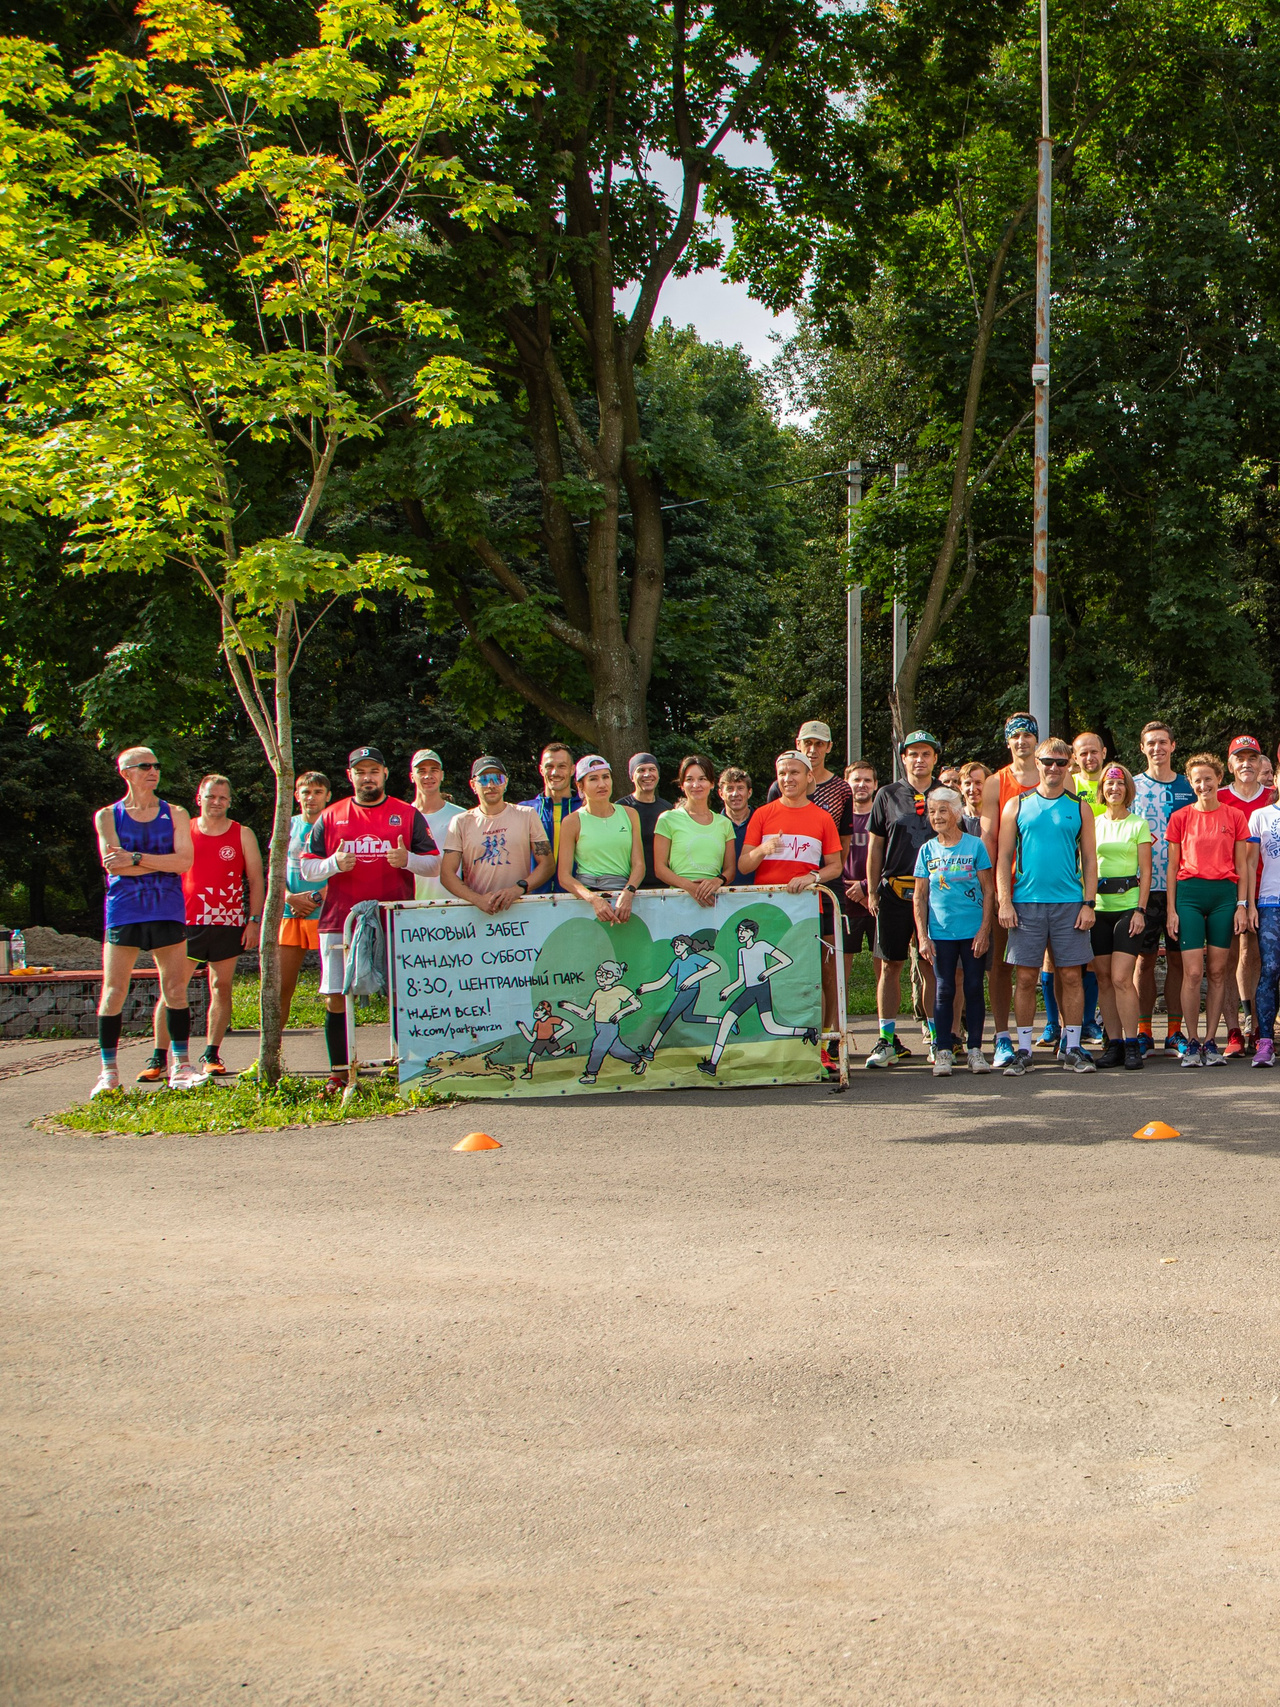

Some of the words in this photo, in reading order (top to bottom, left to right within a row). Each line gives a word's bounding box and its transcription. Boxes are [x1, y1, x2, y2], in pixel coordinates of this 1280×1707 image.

[401, 922, 476, 943] ПАРКОВЫЙ
[485, 920, 530, 937] ЗАБЕГ
[402, 953, 473, 970] КАЖДУЮ
[481, 947, 543, 965] СУББОТУ
[407, 977, 453, 998] 8:30,
[458, 969, 549, 992] ЦЕНТРАЛЬНЫЙ
[553, 971, 586, 985] ПАРК
[407, 1005, 452, 1021] ЖДЁМ
[455, 997, 492, 1018] ВСЕХ!
[408, 1022, 503, 1040] vk.com/parkrunrzn
